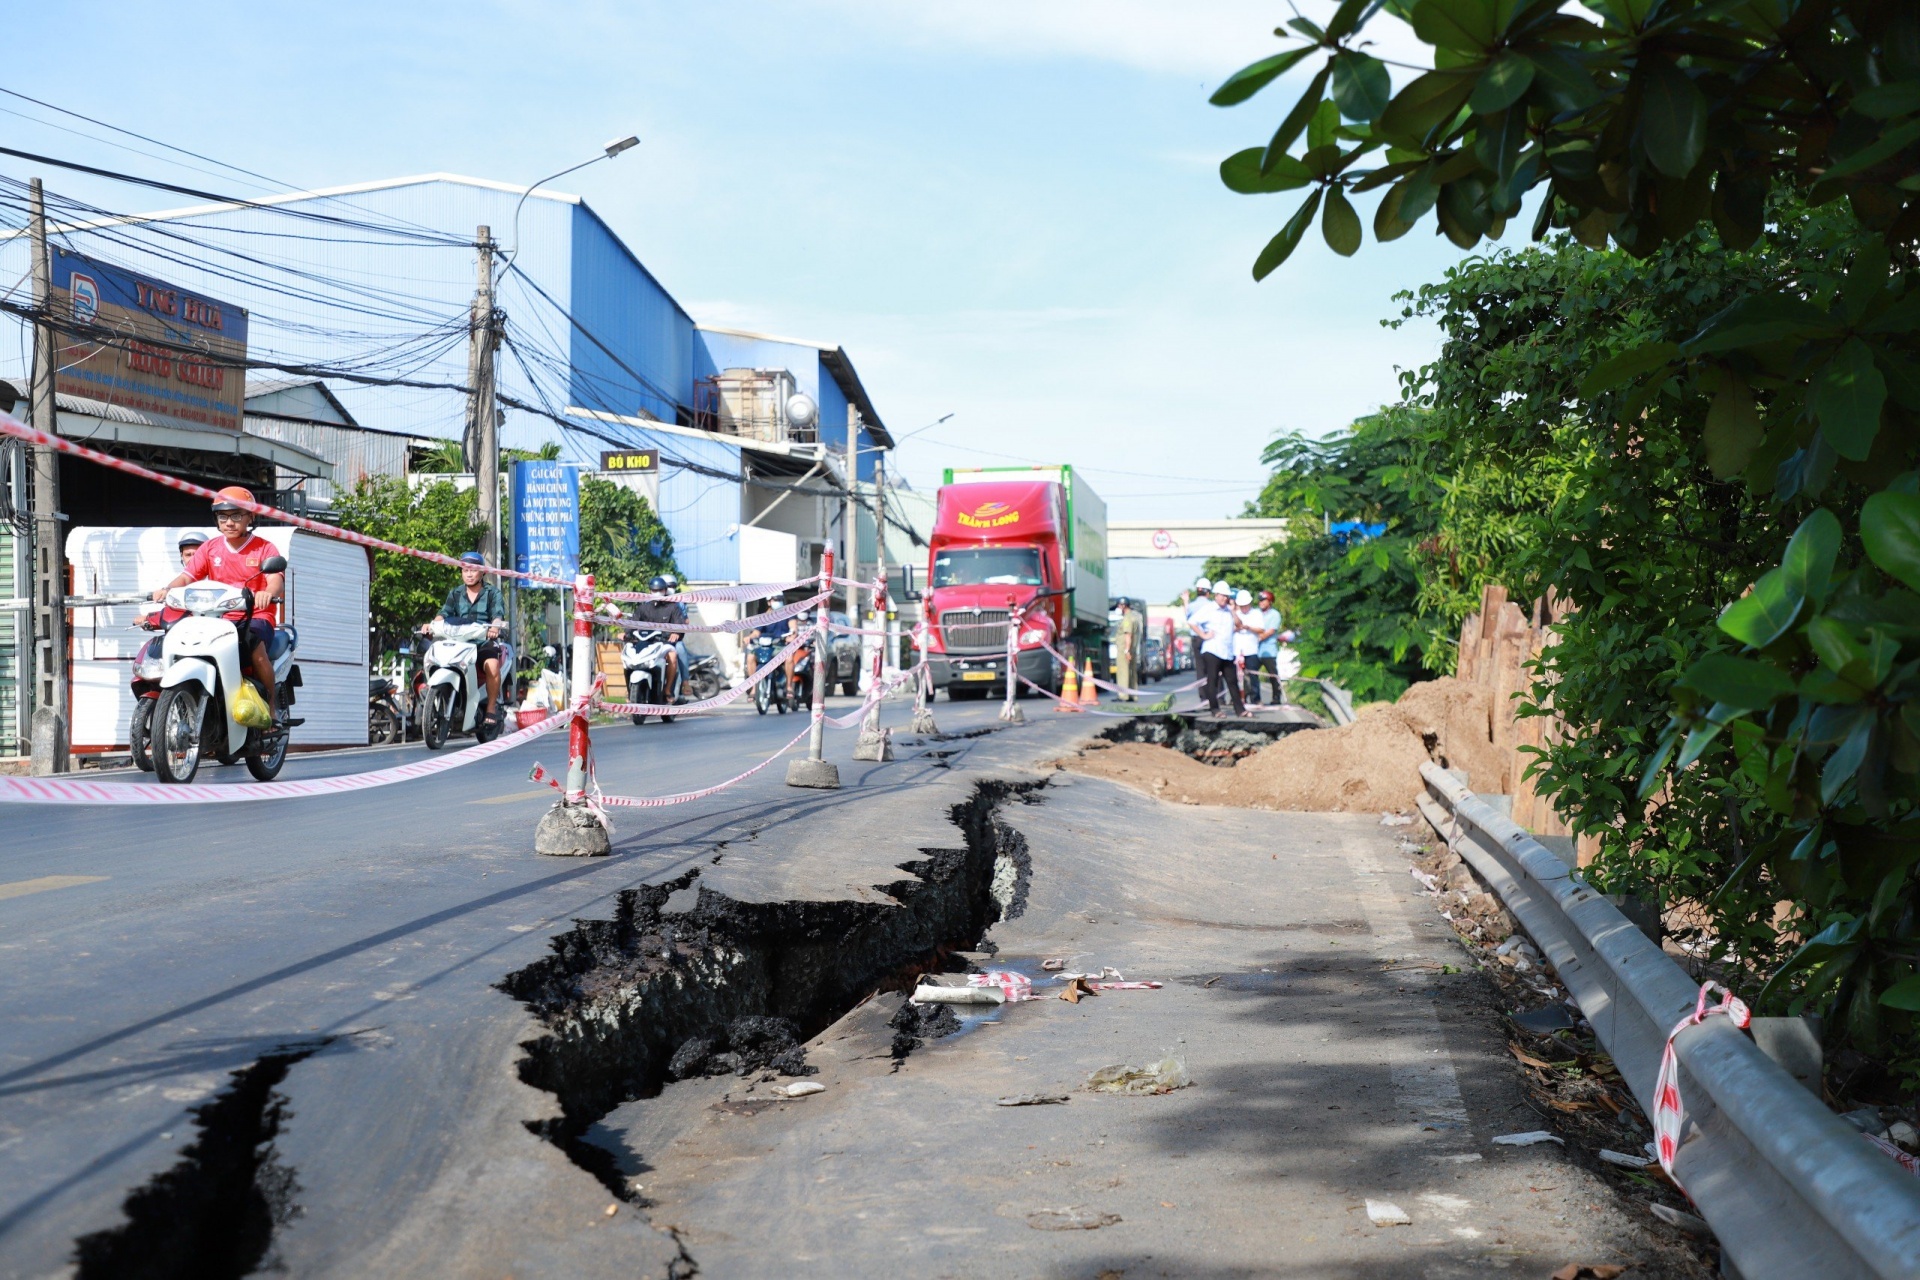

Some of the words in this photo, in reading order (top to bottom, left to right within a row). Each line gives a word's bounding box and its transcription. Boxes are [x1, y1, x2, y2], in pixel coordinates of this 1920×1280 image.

[626, 455, 650, 469] KHO
[526, 480, 546, 493] HÀNH
[546, 481, 568, 494] CHNH
[523, 495, 532, 508] LÀ
[991, 510, 1020, 527] LONG
